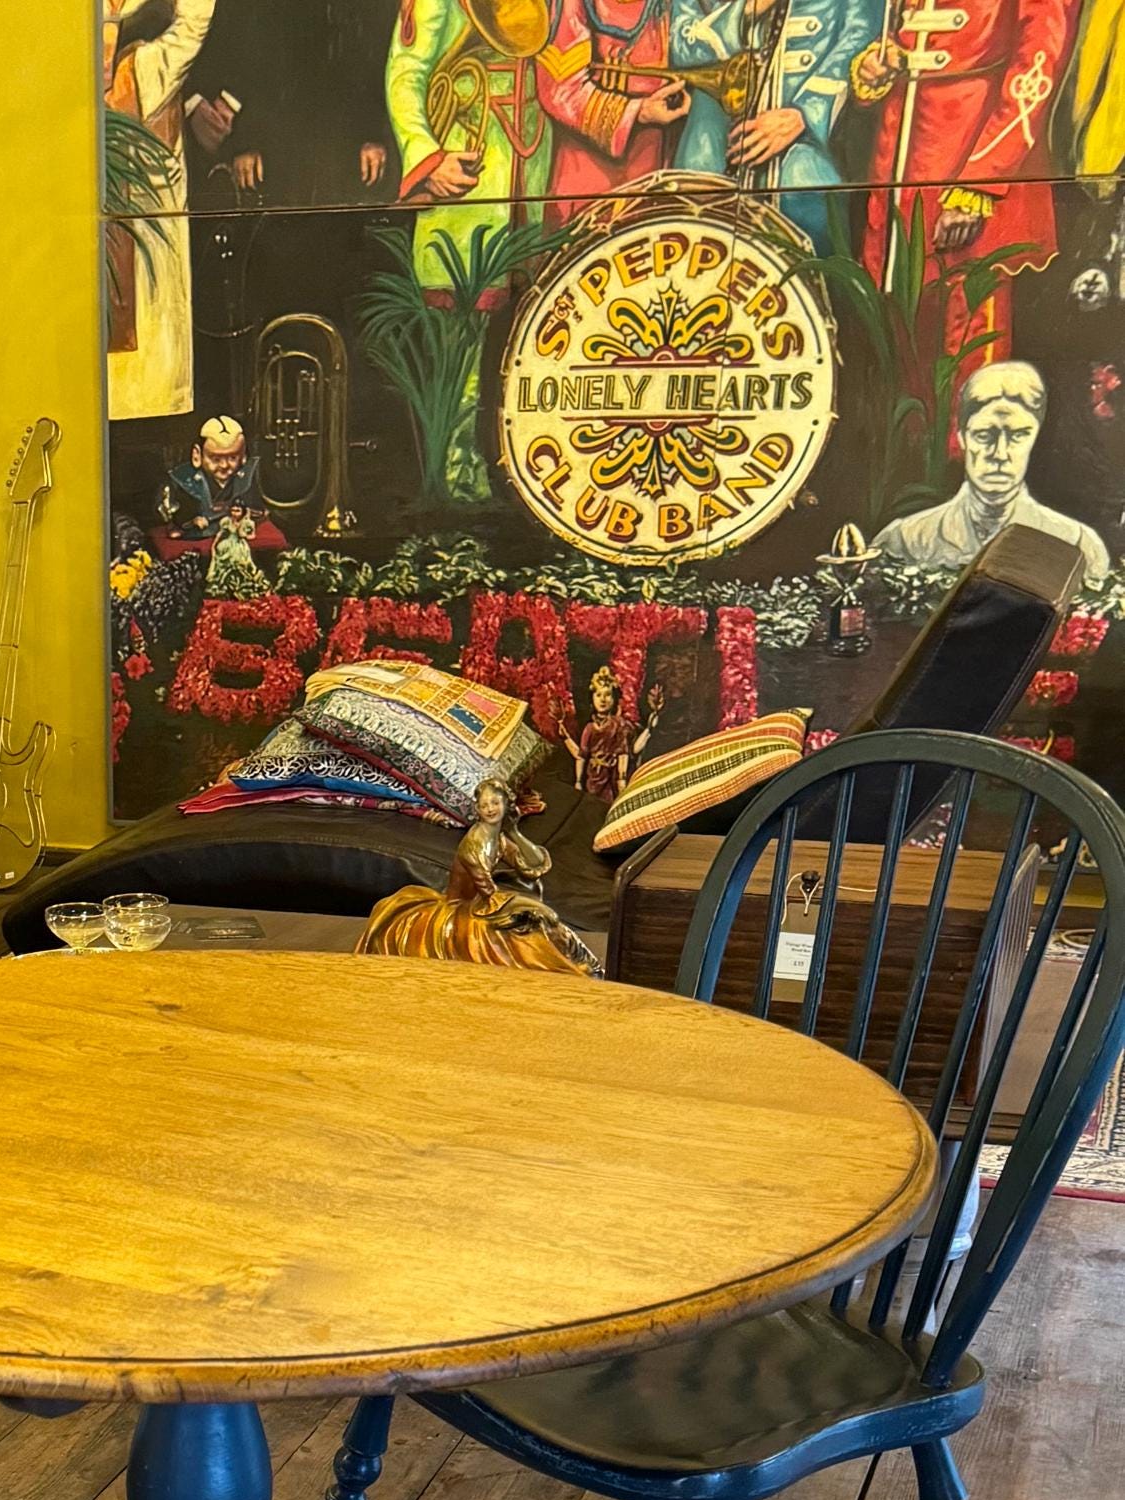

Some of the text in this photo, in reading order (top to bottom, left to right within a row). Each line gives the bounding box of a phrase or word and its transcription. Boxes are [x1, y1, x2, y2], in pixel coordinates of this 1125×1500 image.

[579, 231, 804, 361] PEPPERS
[517, 371, 814, 413] LONELY HEARTS
[525, 432, 795, 542] CLUB BAND
